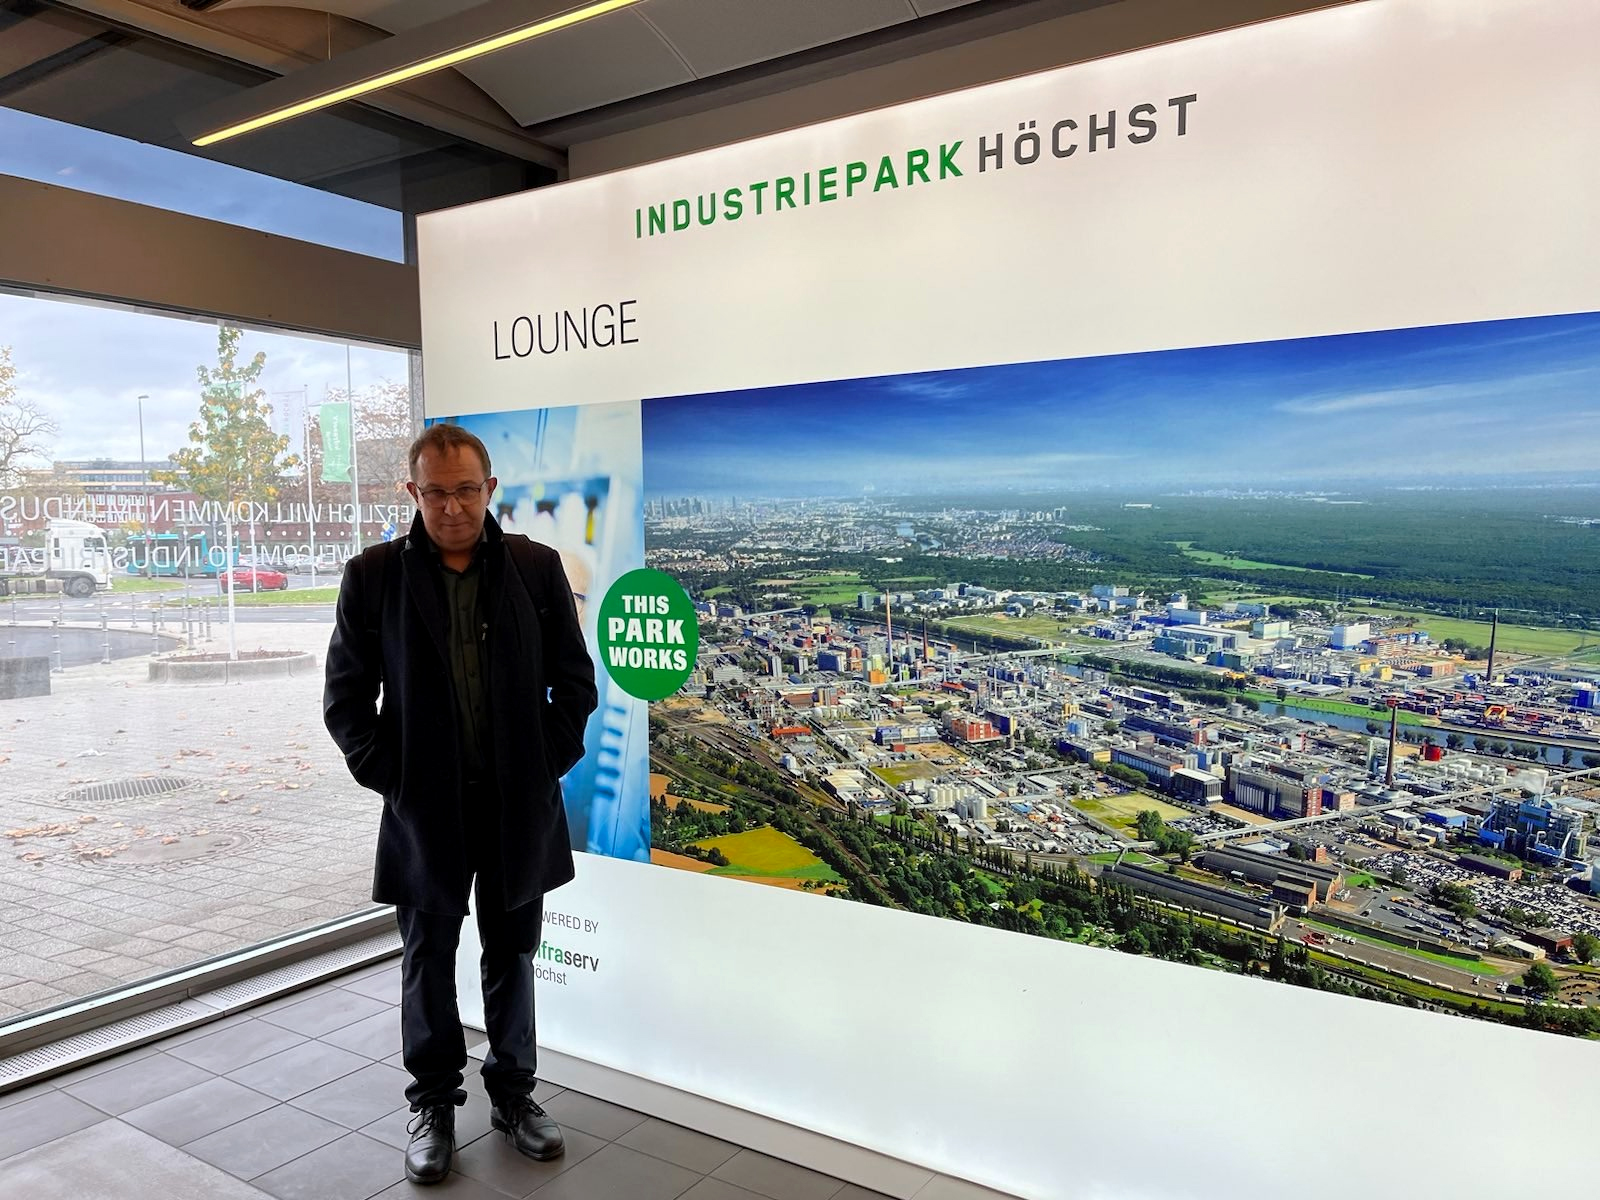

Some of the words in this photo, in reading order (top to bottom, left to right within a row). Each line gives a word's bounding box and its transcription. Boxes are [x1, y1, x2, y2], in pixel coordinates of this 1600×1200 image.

[636, 140, 964, 239] INDUSTRIEPARK
[979, 94, 1197, 173] HÖCHST
[494, 299, 640, 361] LOUNGE
[621, 595, 670, 615] THIS
[608, 617, 686, 645] PARK
[608, 646, 688, 672] WORKS
[542, 910, 581, 930] WERED
[584, 919, 599, 934] BY
[537, 940, 600, 972] fraserv
[535, 963, 568, 986] öchst
